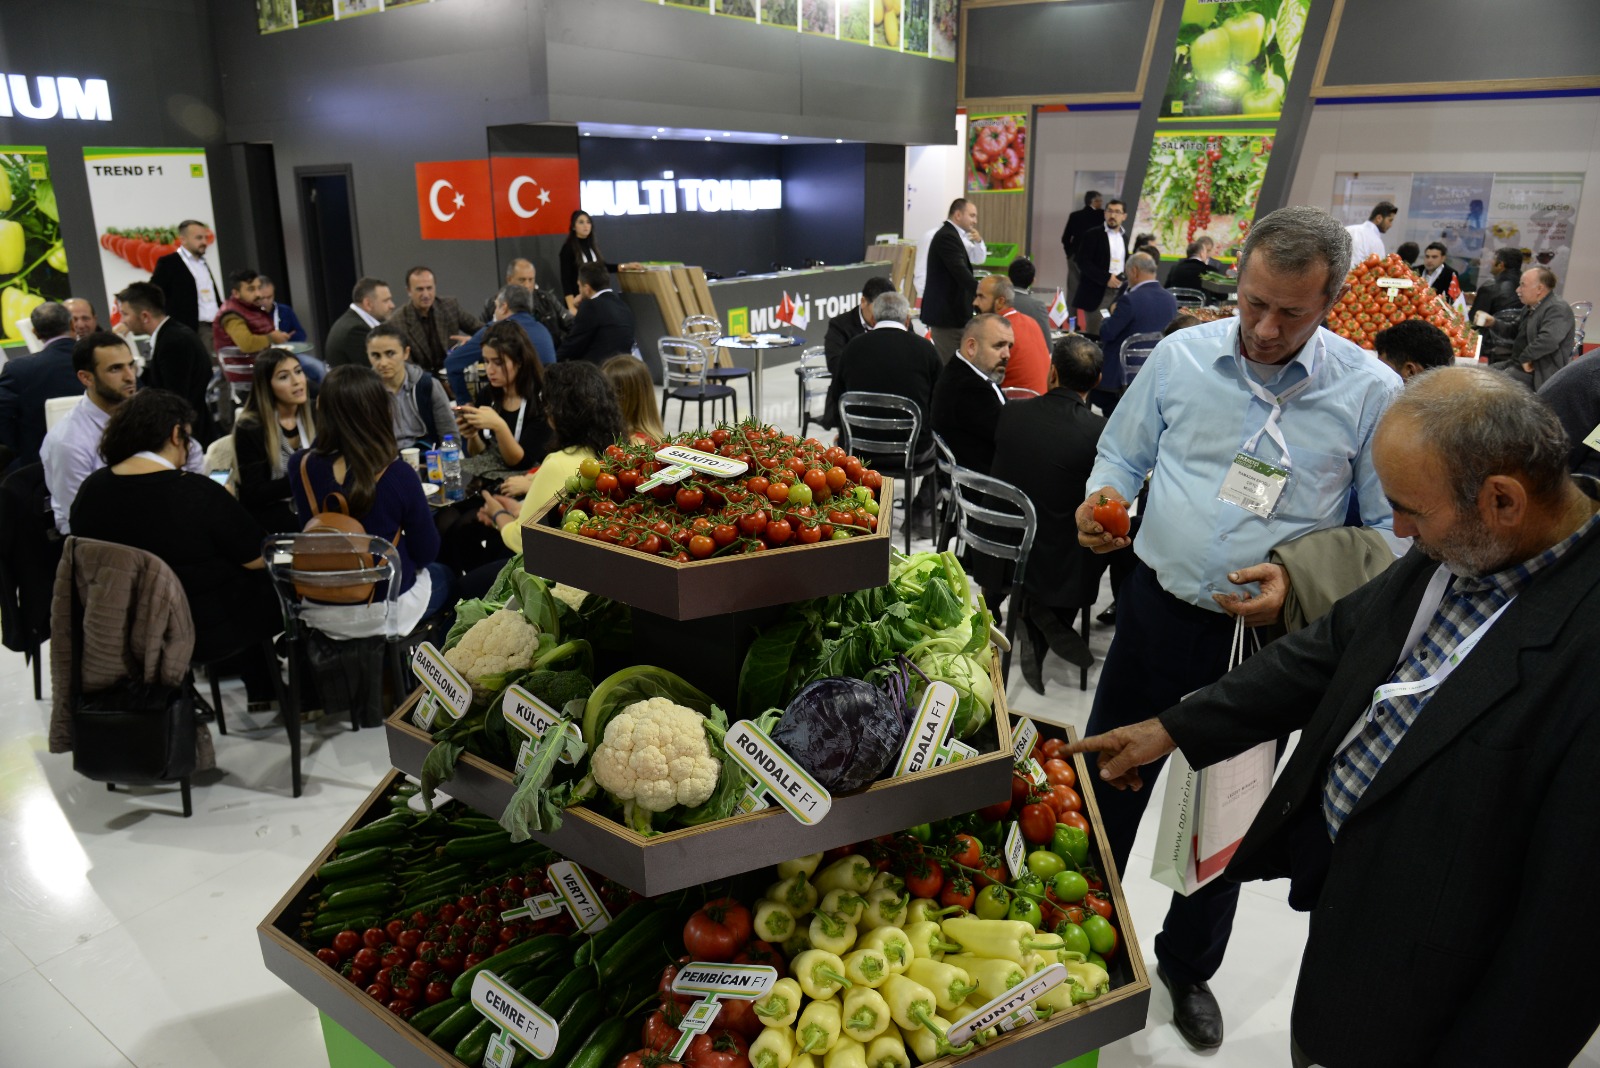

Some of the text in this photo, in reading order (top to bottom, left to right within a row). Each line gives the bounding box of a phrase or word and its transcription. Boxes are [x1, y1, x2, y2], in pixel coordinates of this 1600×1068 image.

[93, 166, 163, 176] TREND F1
[678, 179, 782, 212] TOHUM
[1498, 202, 1529, 212] Green
[815, 292, 863, 321] TOHU
[669, 450, 733, 470] SALKİTO F1
[416, 651, 457, 703] BARCELONA
[455, 694, 466, 710] F1
[908, 700, 945, 774] EDALA F1
[735, 732, 817, 812] RONDALE F1
[562, 873, 597, 919] VERTY F1
[680, 971, 768, 987] PEMBİCAN F1
[485, 989, 540, 1039] CEMRE F1
[969, 981, 1047, 1032] HUNTY F1
